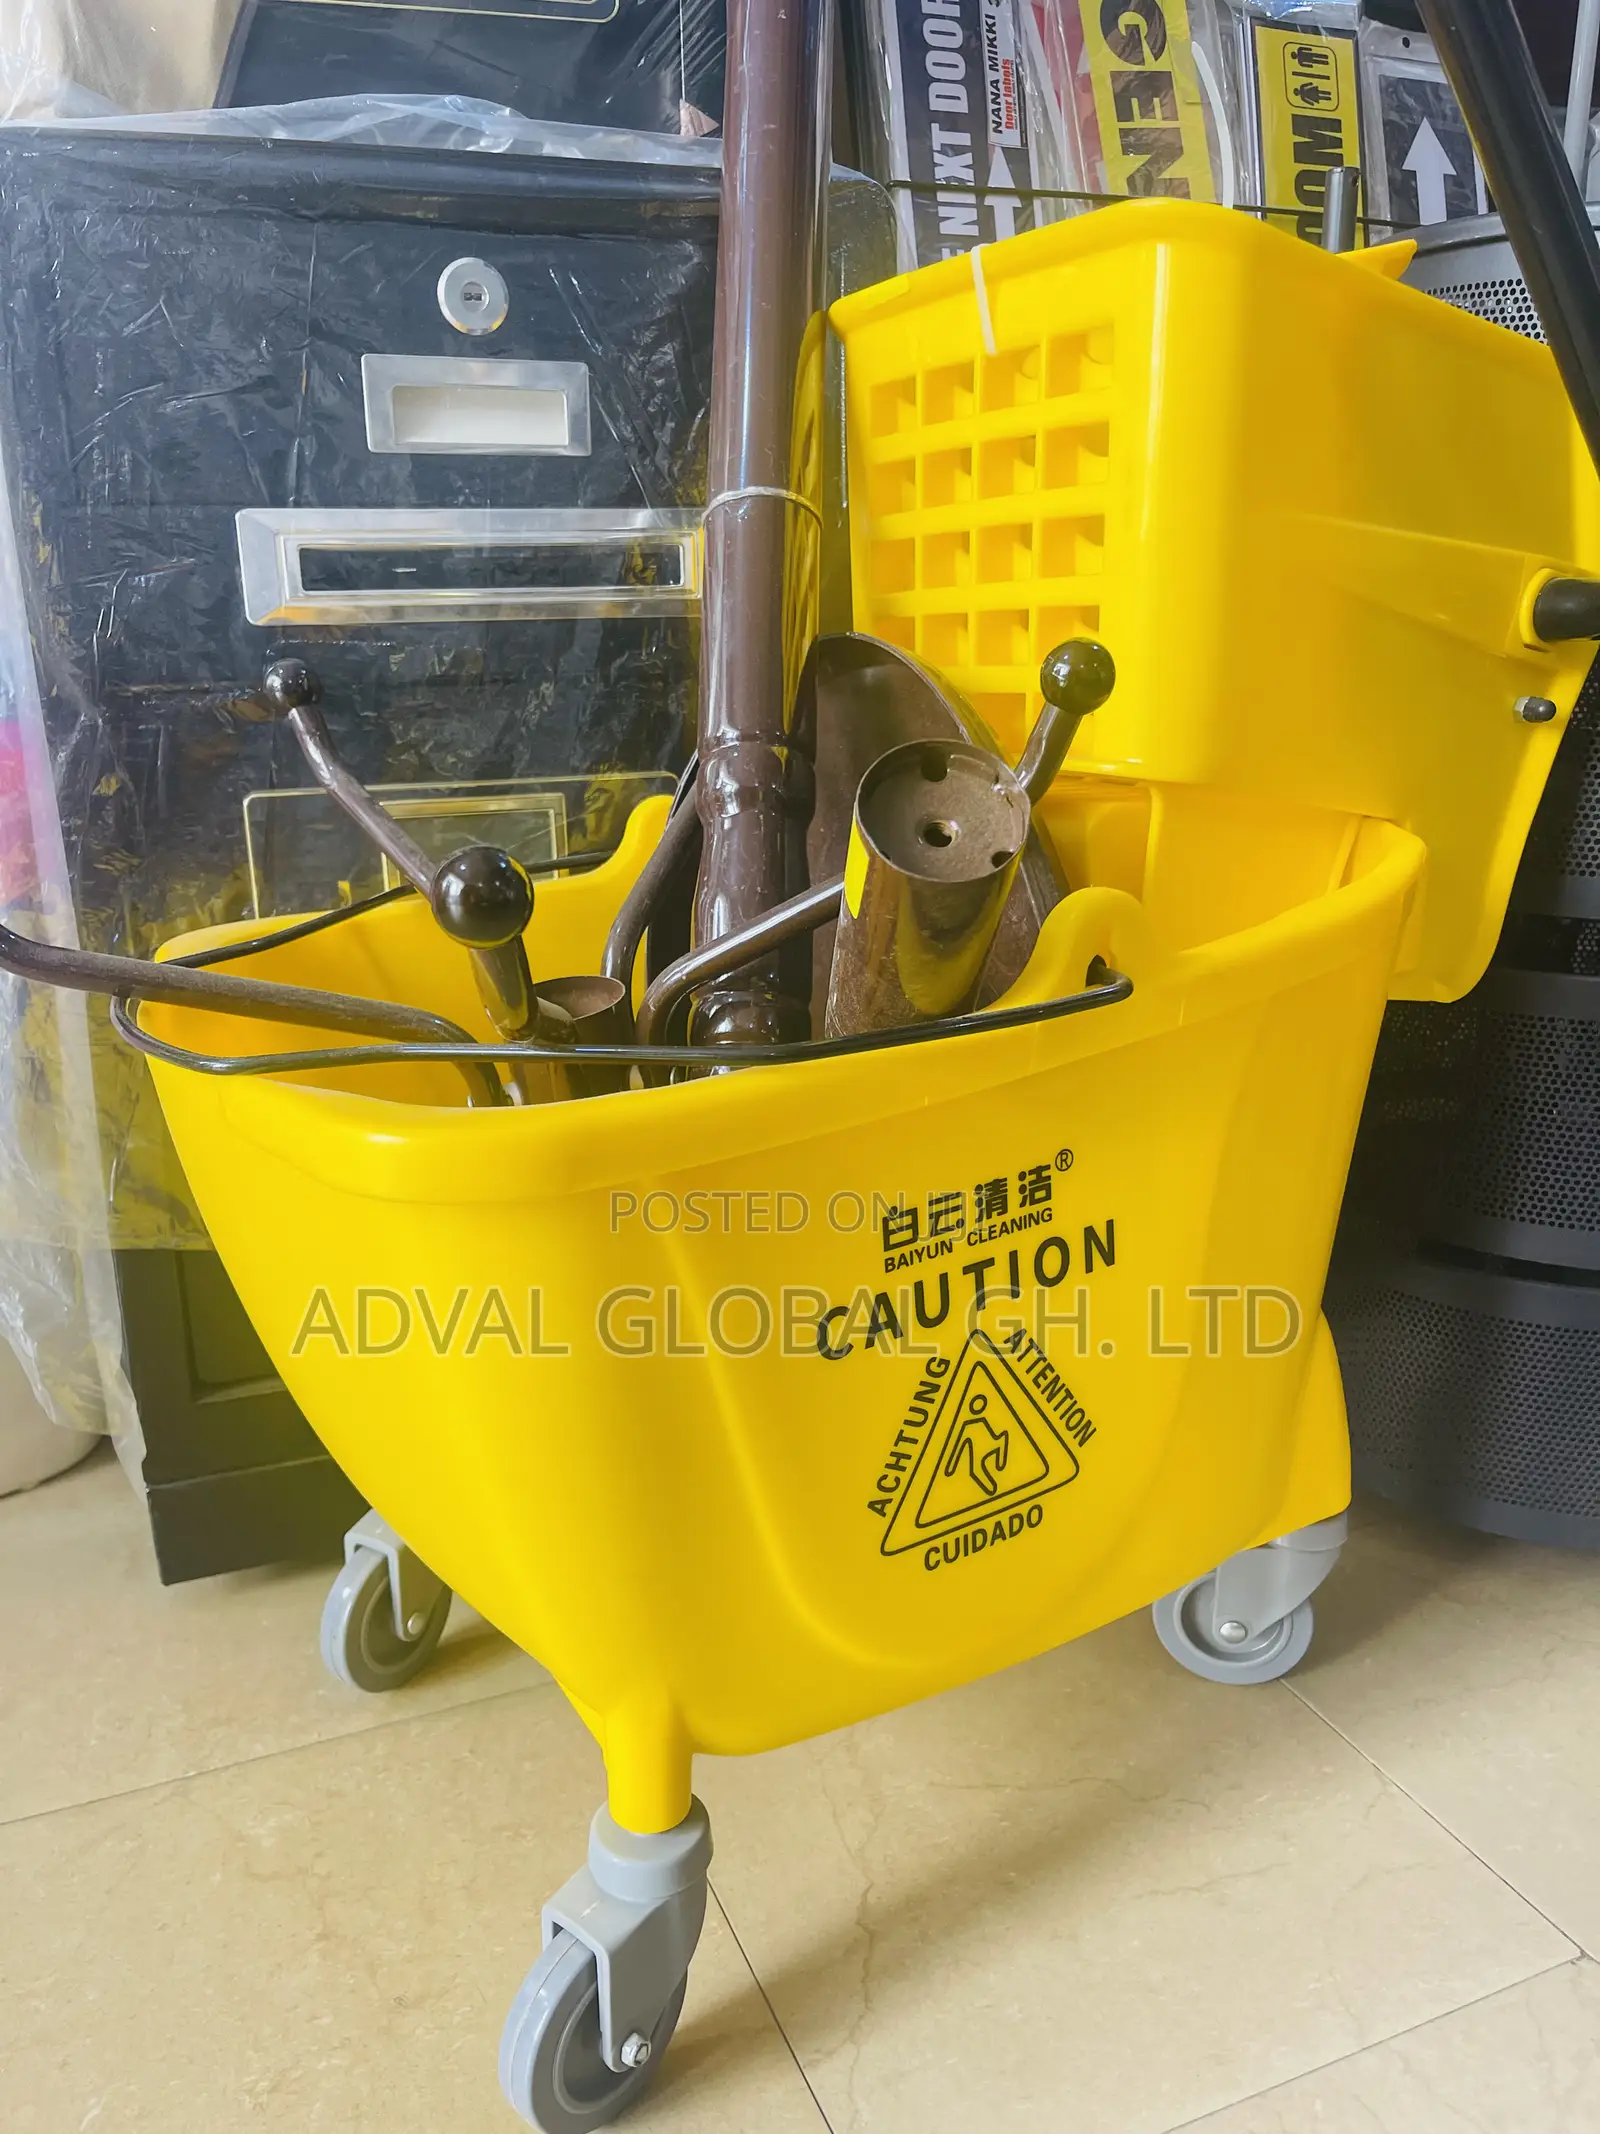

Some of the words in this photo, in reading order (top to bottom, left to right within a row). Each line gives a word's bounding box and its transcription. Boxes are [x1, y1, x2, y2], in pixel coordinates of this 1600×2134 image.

[984, 13, 999, 72] MIKKI
[990, 79, 1003, 134] NANA
[1004, 99, 1015, 130] Door
[882, 1164, 1053, 1252] 白云清洁
[884, 1239, 954, 1274] BAIYUN
[966, 1207, 1053, 1247] CLEANING
[816, 1219, 1116, 1361] CAUTION
[1003, 1328, 1097, 1448] ATTENTION
[866, 1356, 951, 1518] ACHTUNG
[924, 1504, 1044, 1571] CUIDADO
